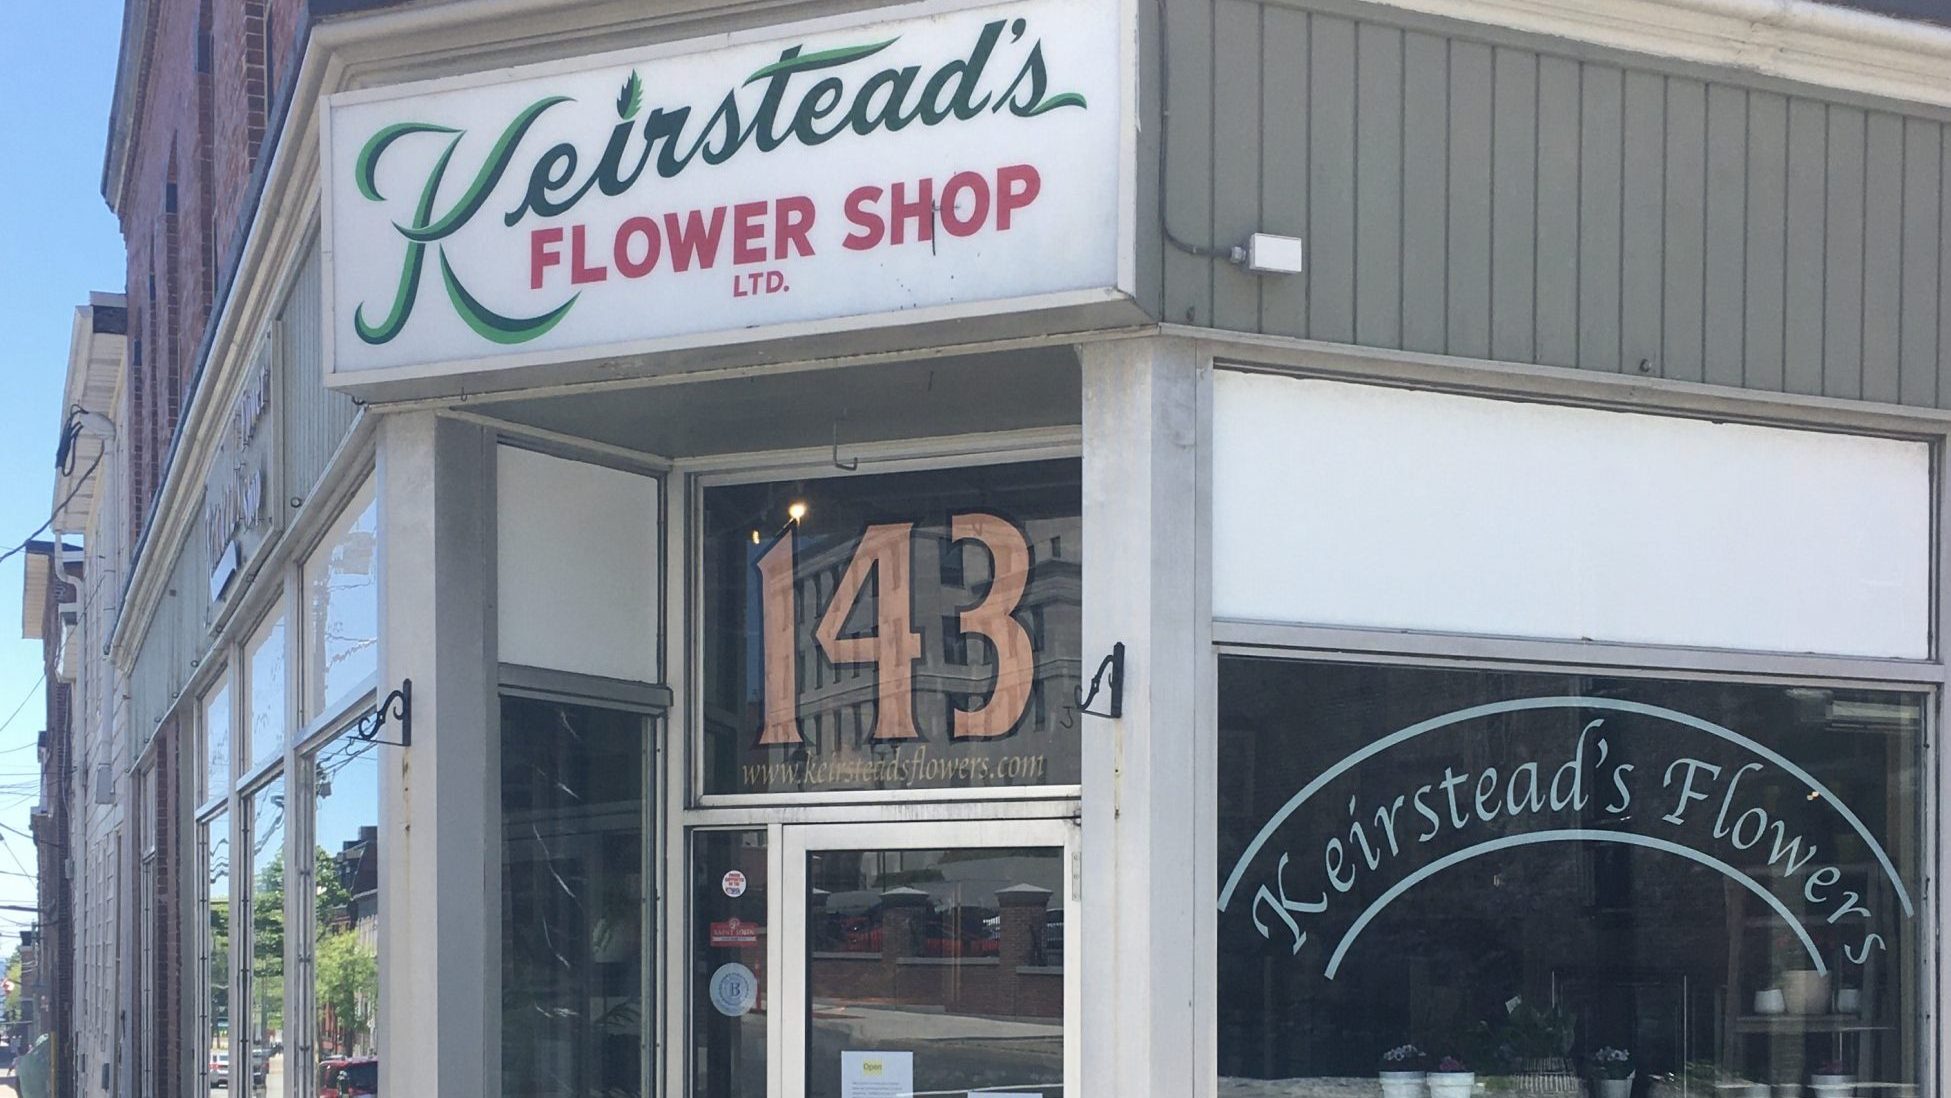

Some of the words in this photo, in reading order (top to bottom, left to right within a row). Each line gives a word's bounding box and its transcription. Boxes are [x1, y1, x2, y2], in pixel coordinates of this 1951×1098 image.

[355, 17, 1088, 345] Keirstead's
[530, 195, 817, 290] FLOWER
[843, 164, 1042, 252] SHOP
[733, 270, 790, 298] LTD.
[754, 510, 1036, 747] 143
[742, 743, 1045, 788] www.keirsteadsflowers.com
[1252, 718, 1634, 955] Keirstead's
[1661, 757, 1887, 966] Flowers
